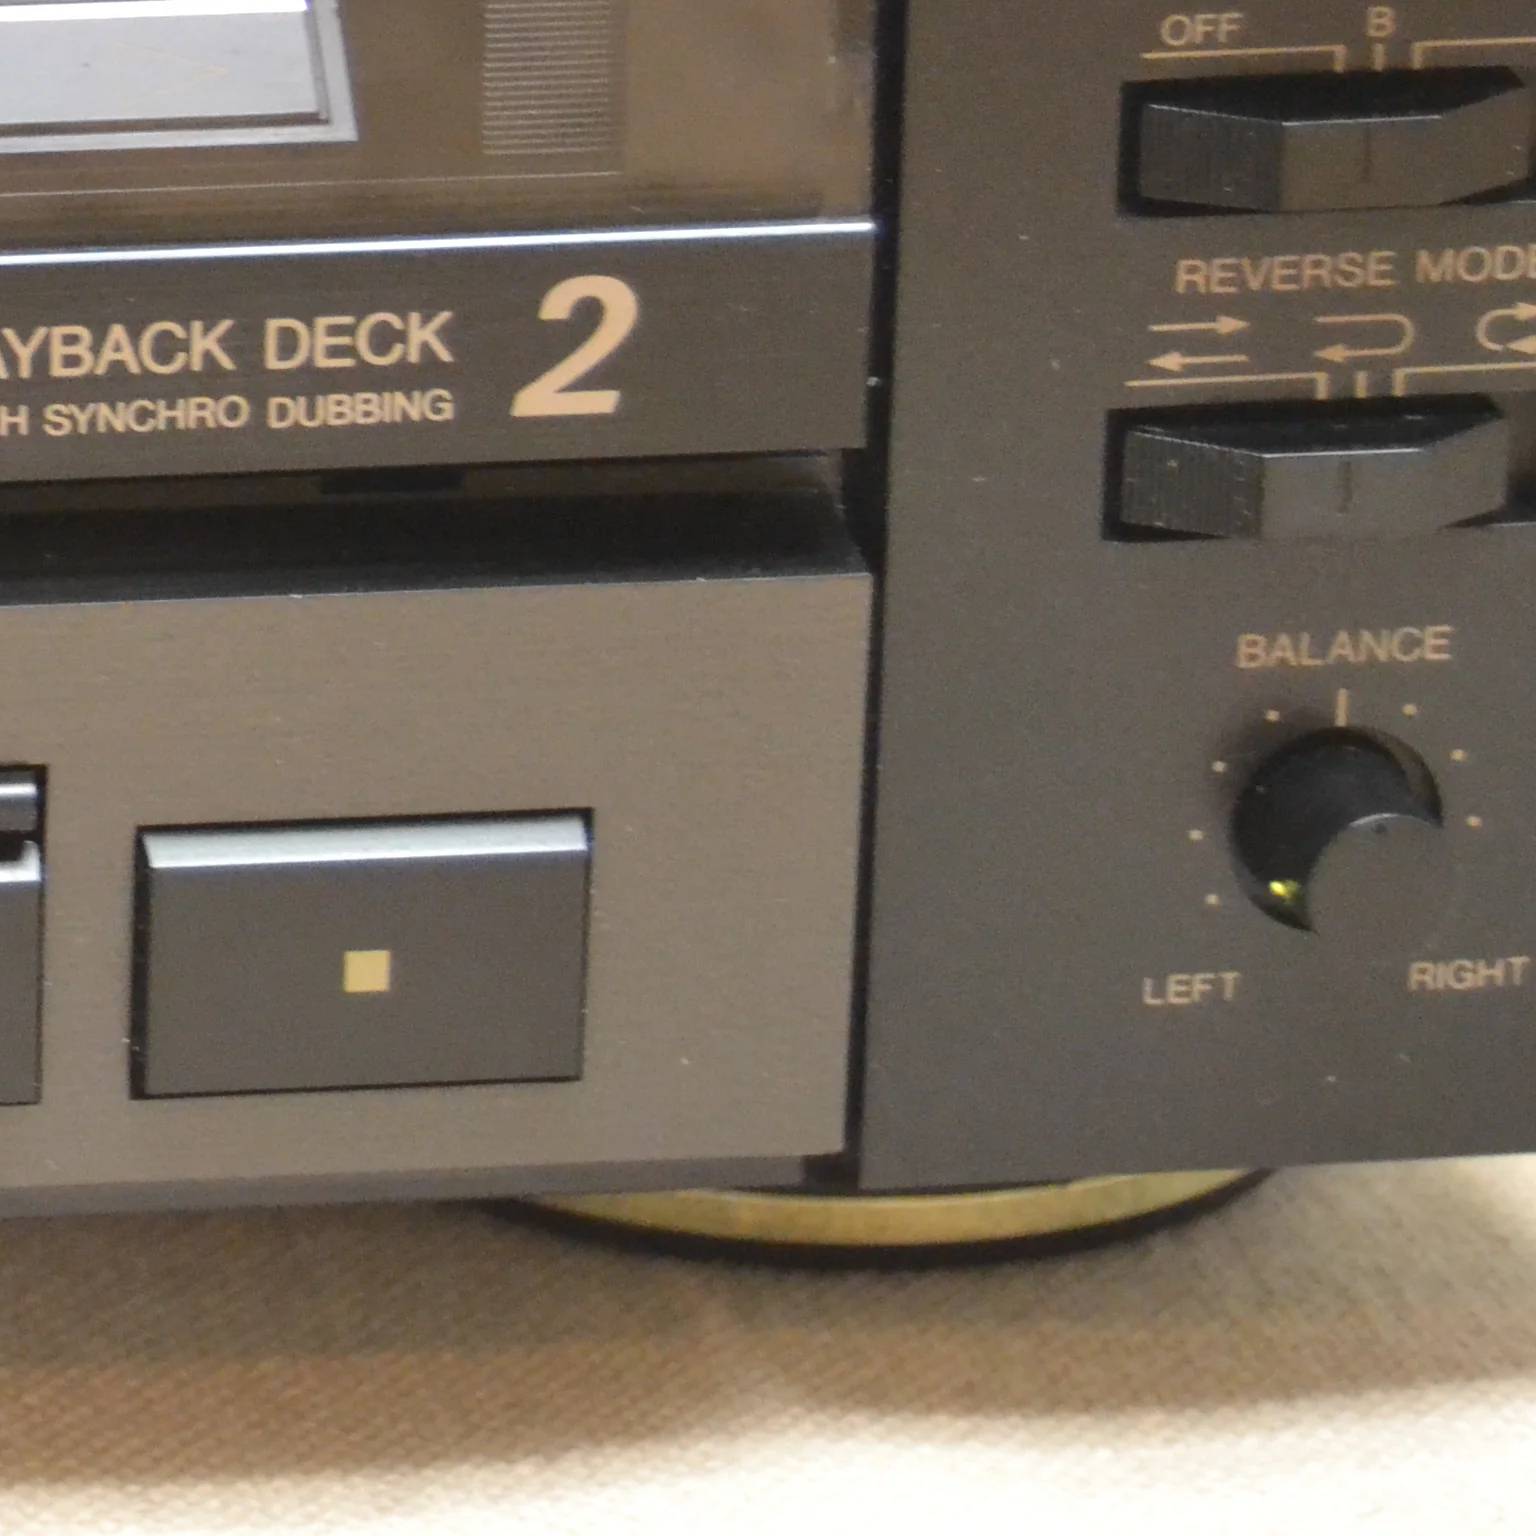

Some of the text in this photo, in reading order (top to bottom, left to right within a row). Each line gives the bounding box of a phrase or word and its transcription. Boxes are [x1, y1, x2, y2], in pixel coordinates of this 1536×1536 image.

[1160, 12, 1245, 46] OFF
[1366, 6, 1396, 37] B
[1174, 249, 1399, 294] REVERSE
[265, 310, 456, 371] DECK
[509, 274, 640, 419] 2
[43, 395, 250, 437] SYNCHRO
[267, 389, 456, 430] DUBBING
[1236, 624, 1456, 669] BALANCE
[1141, 971, 1242, 1006] LEFT
[1407, 955, 1532, 992] RIGHT
